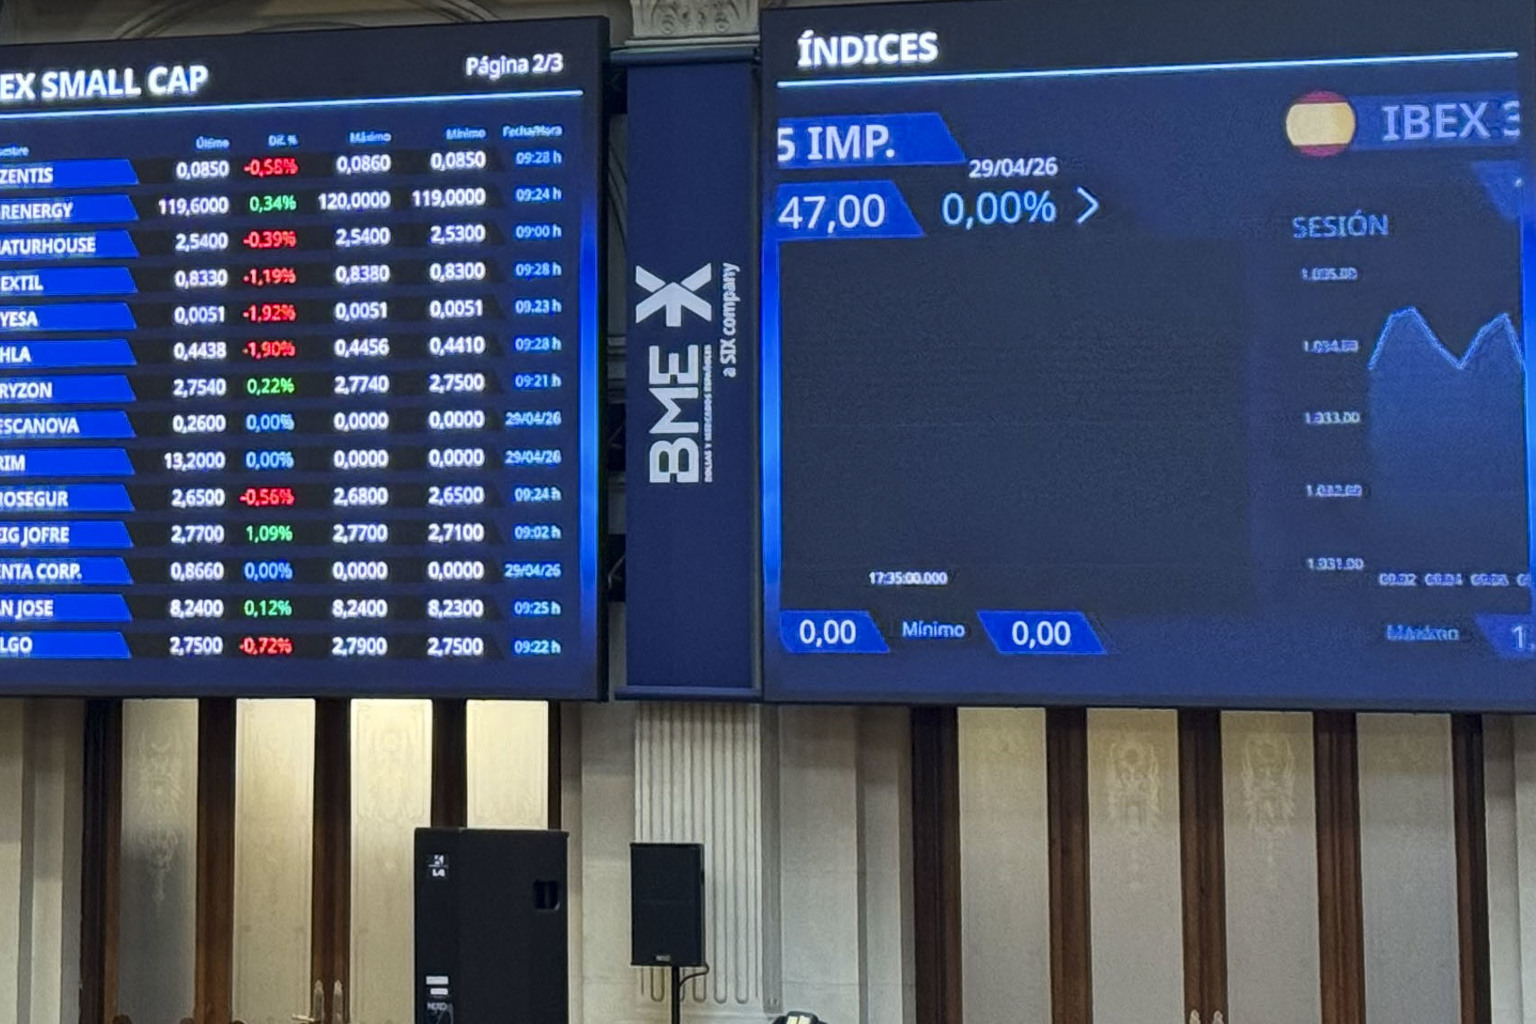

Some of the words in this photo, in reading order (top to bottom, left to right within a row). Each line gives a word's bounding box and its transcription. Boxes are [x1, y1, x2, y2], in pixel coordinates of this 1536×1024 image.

[798, 31, 939, 69] ÍNDICES
[466, 55, 529, 80] Página
[533, 53, 563, 74] 2/3
[42, 69, 141, 99] SMALL
[147, 66, 207, 94] CAP
[1382, 102, 1490, 141] IBEX
[777, 127, 795, 162] 5
[808, 124, 895, 161] IMP.
[176, 160, 230, 179] 0,0850
[337, 154, 390, 173] 0,0860
[430, 150, 486, 170] 0,0850
[553, 149, 561, 164] h
[969, 157, 1058, 178] 29/04/26
[159, 196, 229, 216] 119,6000
[250, 195, 296, 213] 0,34%
[318, 192, 390, 211] 120,0000
[412, 188, 485, 207] 119,0000
[553, 186, 561, 201] h
[778, 194, 885, 233] 47,00
[942, 190, 1056, 230] 0,00%
[176, 232, 228, 251] 2,5400
[336, 227, 390, 247] 2,5400
[430, 223, 485, 244] 2,5300
[553, 224, 561, 238] h
[1292, 209, 1388, 239] SESIÓN
[175, 268, 228, 288] 0,8330
[243, 267, 296, 286] -1,19%
[336, 263, 390, 283] 0,8380
[430, 261, 485, 281] 0,8300
[553, 262, 561, 276] h
[175, 305, 225, 326] 0,0051
[243, 303, 296, 322] -1,92%
[336, 301, 387, 321] 0,0051
[430, 298, 482, 318] 0,0051
[553, 299, 561, 313] h
[723, 263, 741, 335] company
[174, 340, 227, 361] 0,4438
[334, 337, 389, 357] 0,4456
[430, 334, 485, 355] 0,4410
[553, 337, 561, 350] h
[720, 339, 736, 364] SIX
[174, 378, 226, 399] 2,7540
[247, 377, 294, 396] 0,22%
[334, 374, 389, 395] 2,7740
[429, 373, 484, 393] 2,7500
[553, 374, 561, 388] h
[723, 368, 736, 377] a
[173, 414, 225, 434] 0,2600
[246, 413, 294, 432] 0,00%
[334, 411, 389, 431] 0,0000
[429, 410, 484, 431] 0,0000
[649, 345, 699, 483] BME
[164, 450, 225, 471] 13,2000
[245, 450, 293, 470] 0,00%
[334, 449, 388, 468] 0,0000
[429, 448, 484, 468] 0,0000
[172, 488, 225, 508] 2,6500
[240, 488, 294, 507] -0,56%
[333, 486, 388, 506] 2,6800
[429, 486, 484, 506] 2,6500
[551, 487, 561, 501] h
[22, 526, 69, 545] JOFRE
[171, 524, 224, 545] 2,7700
[246, 524, 292, 543] 1,09%
[333, 523, 388, 543] 2,7700
[429, 522, 484, 542] 2,7100
[551, 525, 561, 538] h
[36, 562, 81, 580] CORP.
[171, 561, 224, 581] 0,8660
[244, 561, 292, 579] 0,00%
[333, 560, 387, 580] 0,0000
[429, 560, 484, 579] 0,0000
[13, 599, 53, 618] JOSE
[170, 598, 223, 618] 8,2400
[244, 599, 292, 617] 0,12%
[332, 598, 387, 618] 8,2400
[428, 598, 484, 618] 8,2300
[551, 600, 561, 614] h
[170, 636, 222, 656] 2,7500
[240, 636, 292, 654] -0,72%
[332, 636, 387, 657] 2,7900
[428, 636, 484, 657] 2,7500
[551, 639, 561, 653] h
[799, 619, 856, 648] 0,00
[902, 620, 965, 637] Mínimo
[1011, 620, 1071, 649] 0,00
